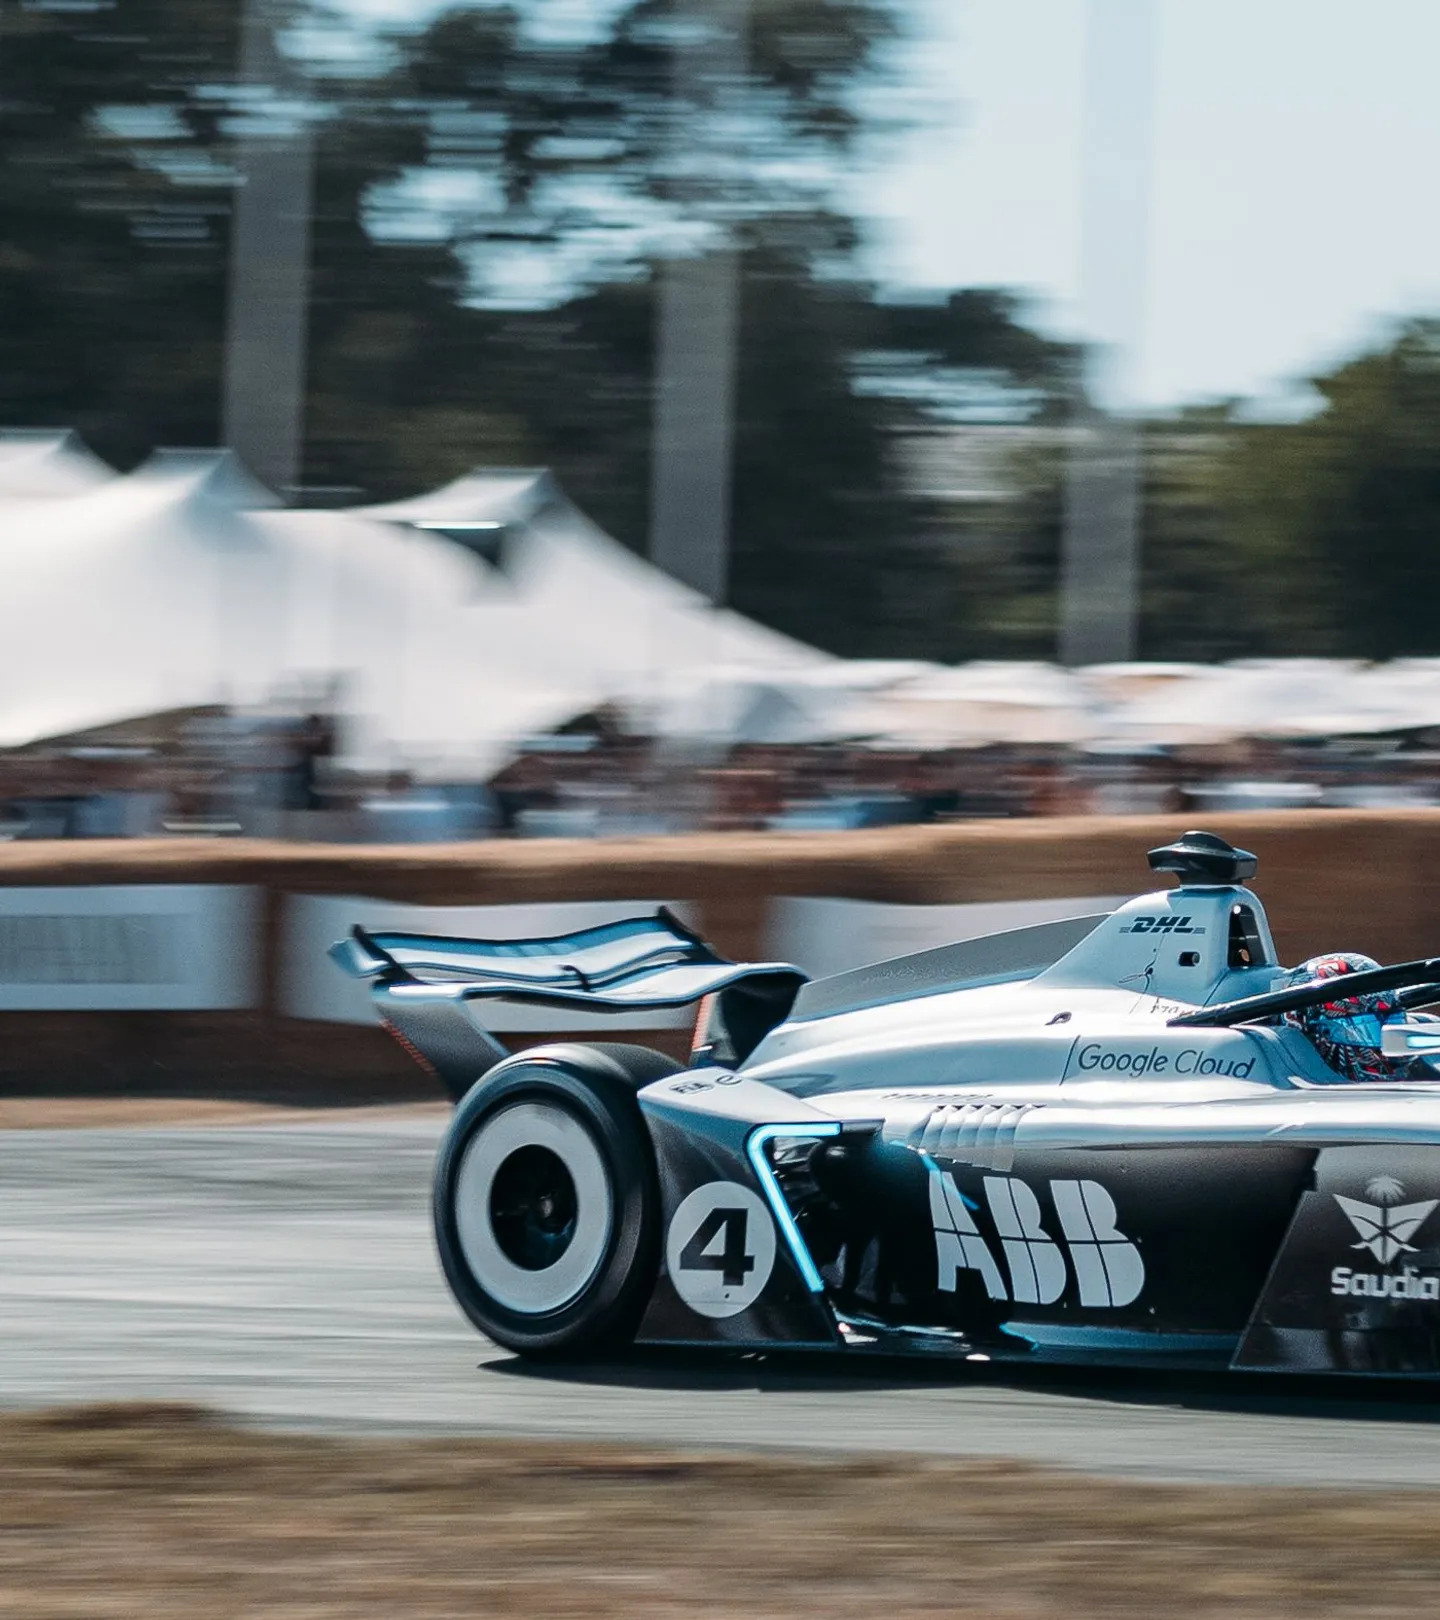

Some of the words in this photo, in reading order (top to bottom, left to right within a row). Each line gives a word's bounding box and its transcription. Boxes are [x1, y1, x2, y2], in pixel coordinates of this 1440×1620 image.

[1130, 916, 1192, 934] DHL
[1078, 1043, 1168, 1078] Google
[1174, 1049, 1256, 1079] Cloud
[679, 1207, 754, 1286] 4
[929, 1171, 1145, 1307] ABB
[1330, 1265, 1440, 1300] Saudia
